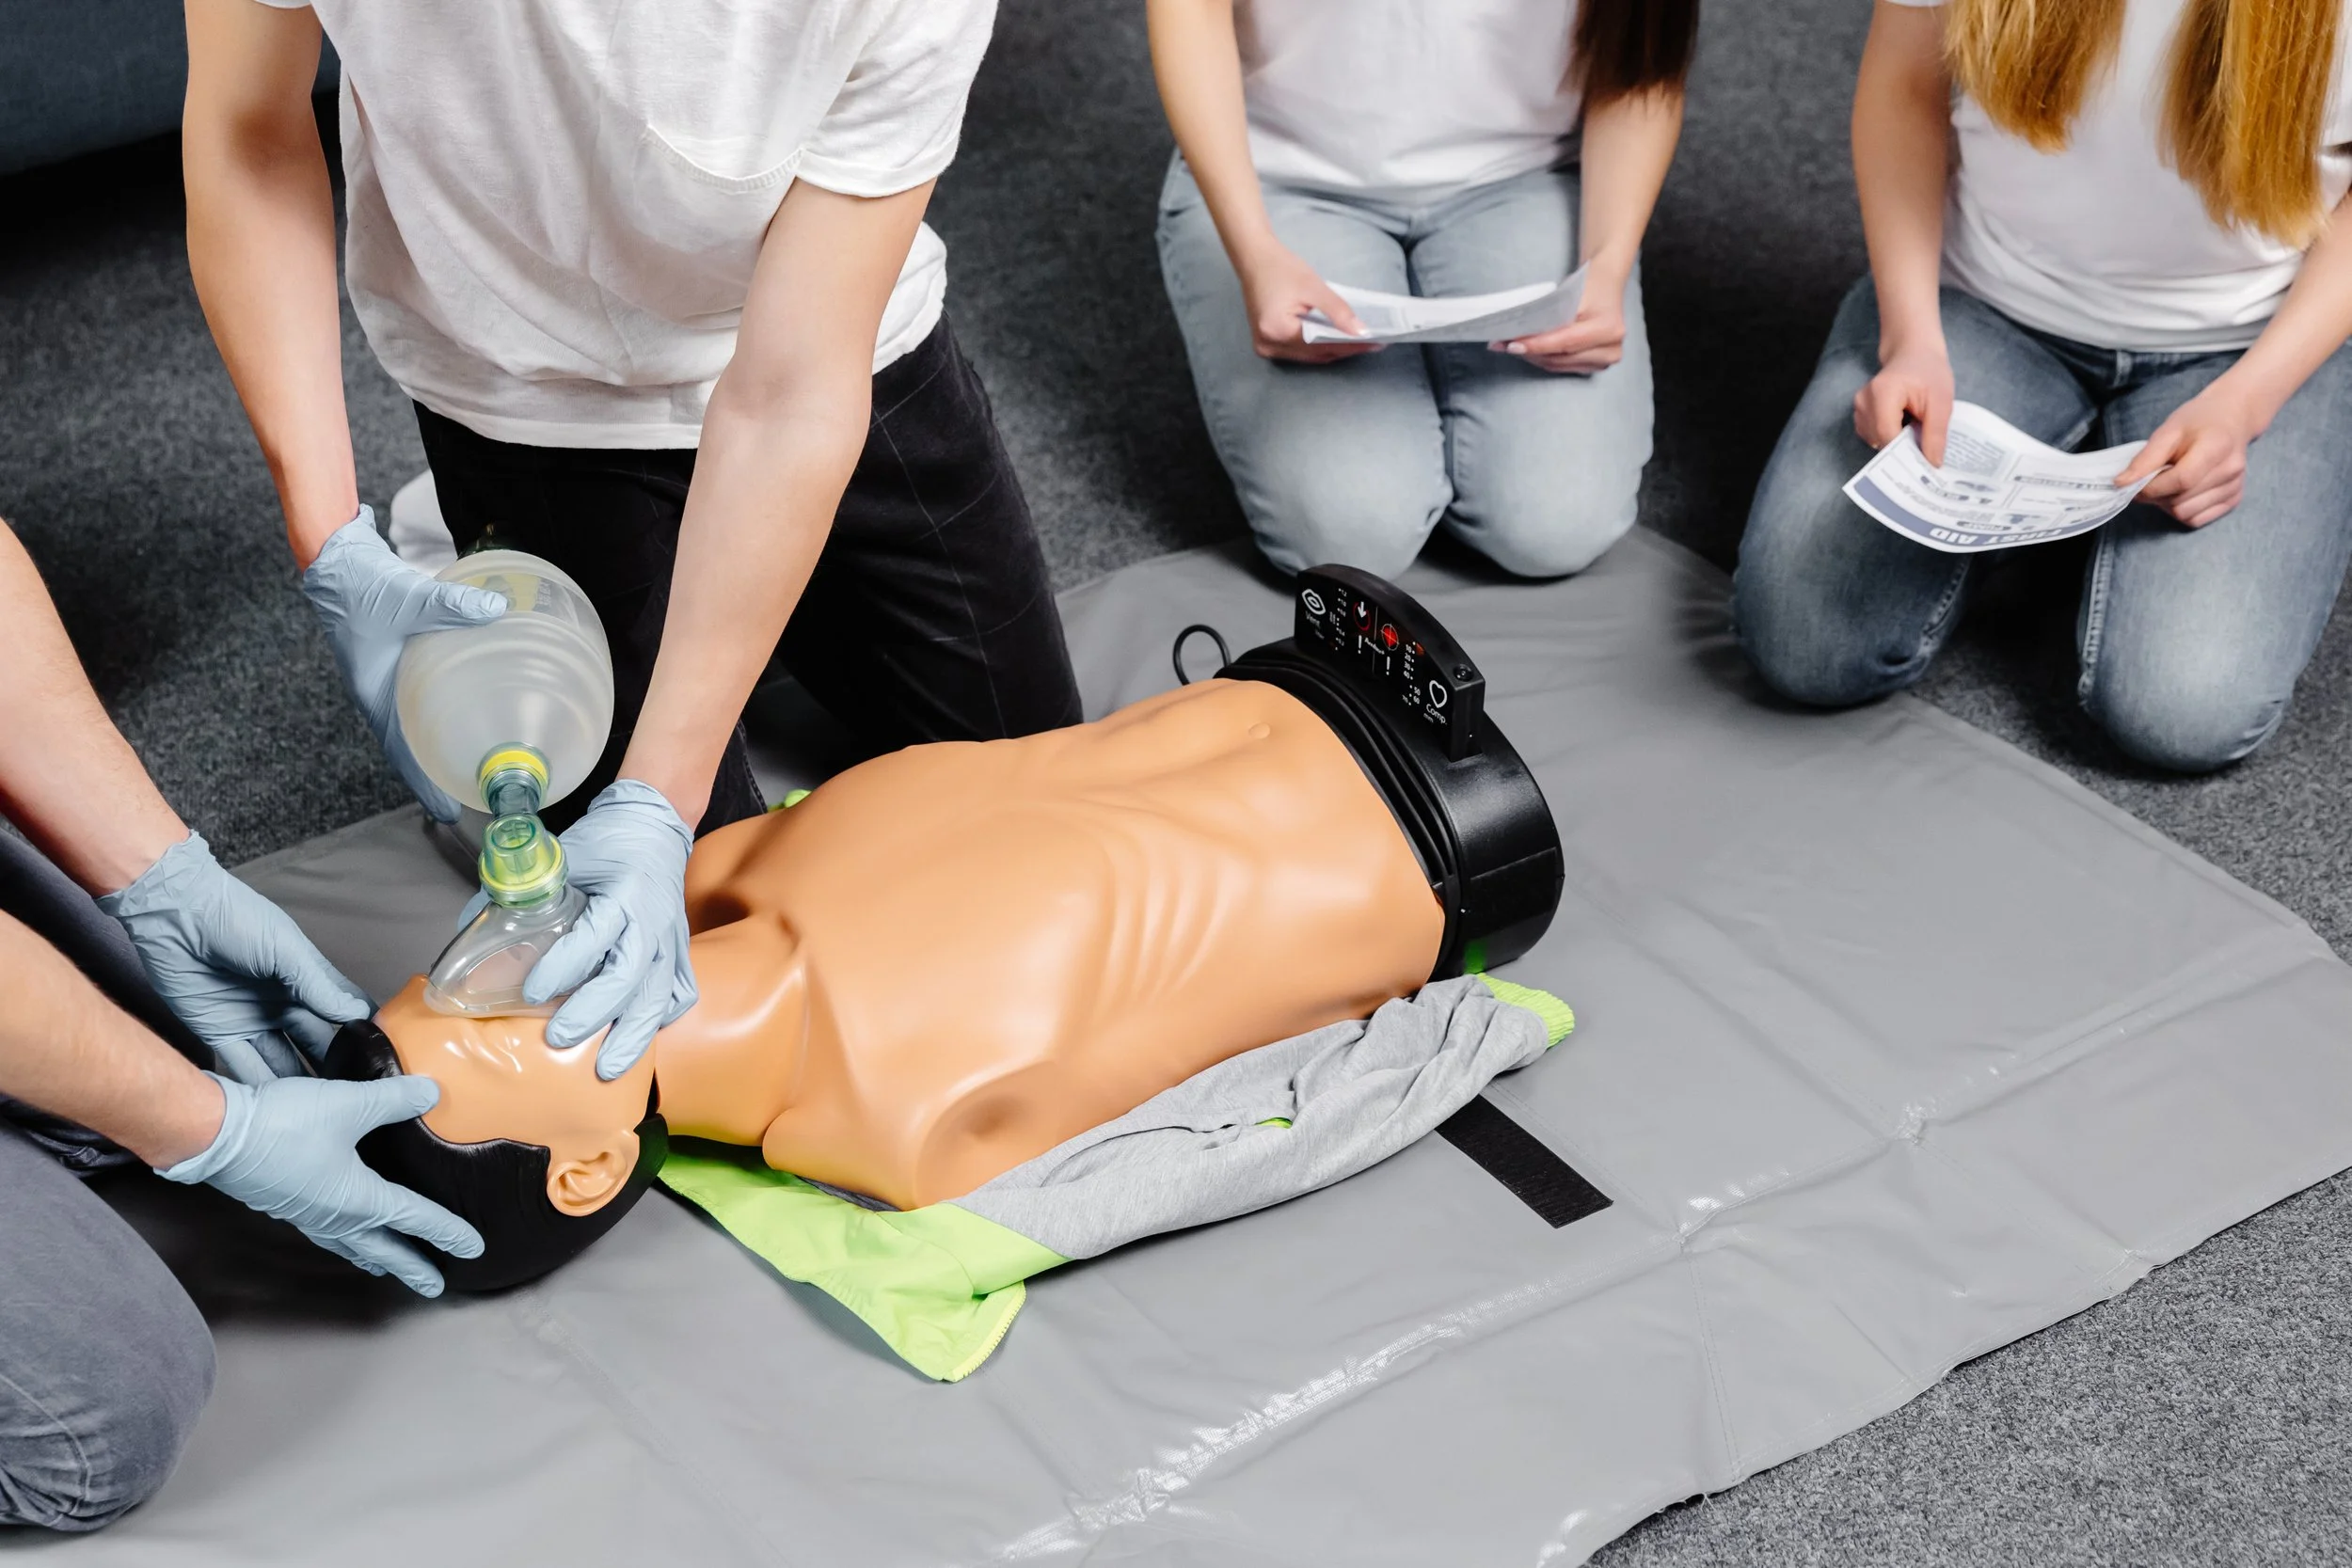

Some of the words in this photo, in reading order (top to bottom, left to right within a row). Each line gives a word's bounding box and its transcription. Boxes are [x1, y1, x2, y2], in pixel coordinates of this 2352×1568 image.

[1929, 527, 1979, 545] AID
[1982, 529, 2063, 546] FIRST
[1406, 643, 1412, 653] 10
[1404, 652, 1411, 661] 20
[1404, 661, 1411, 671] 30
[1413, 686, 1421, 696] 50
[1413, 695, 1421, 705] 60
[1425, 703, 1447, 725] Comp.
